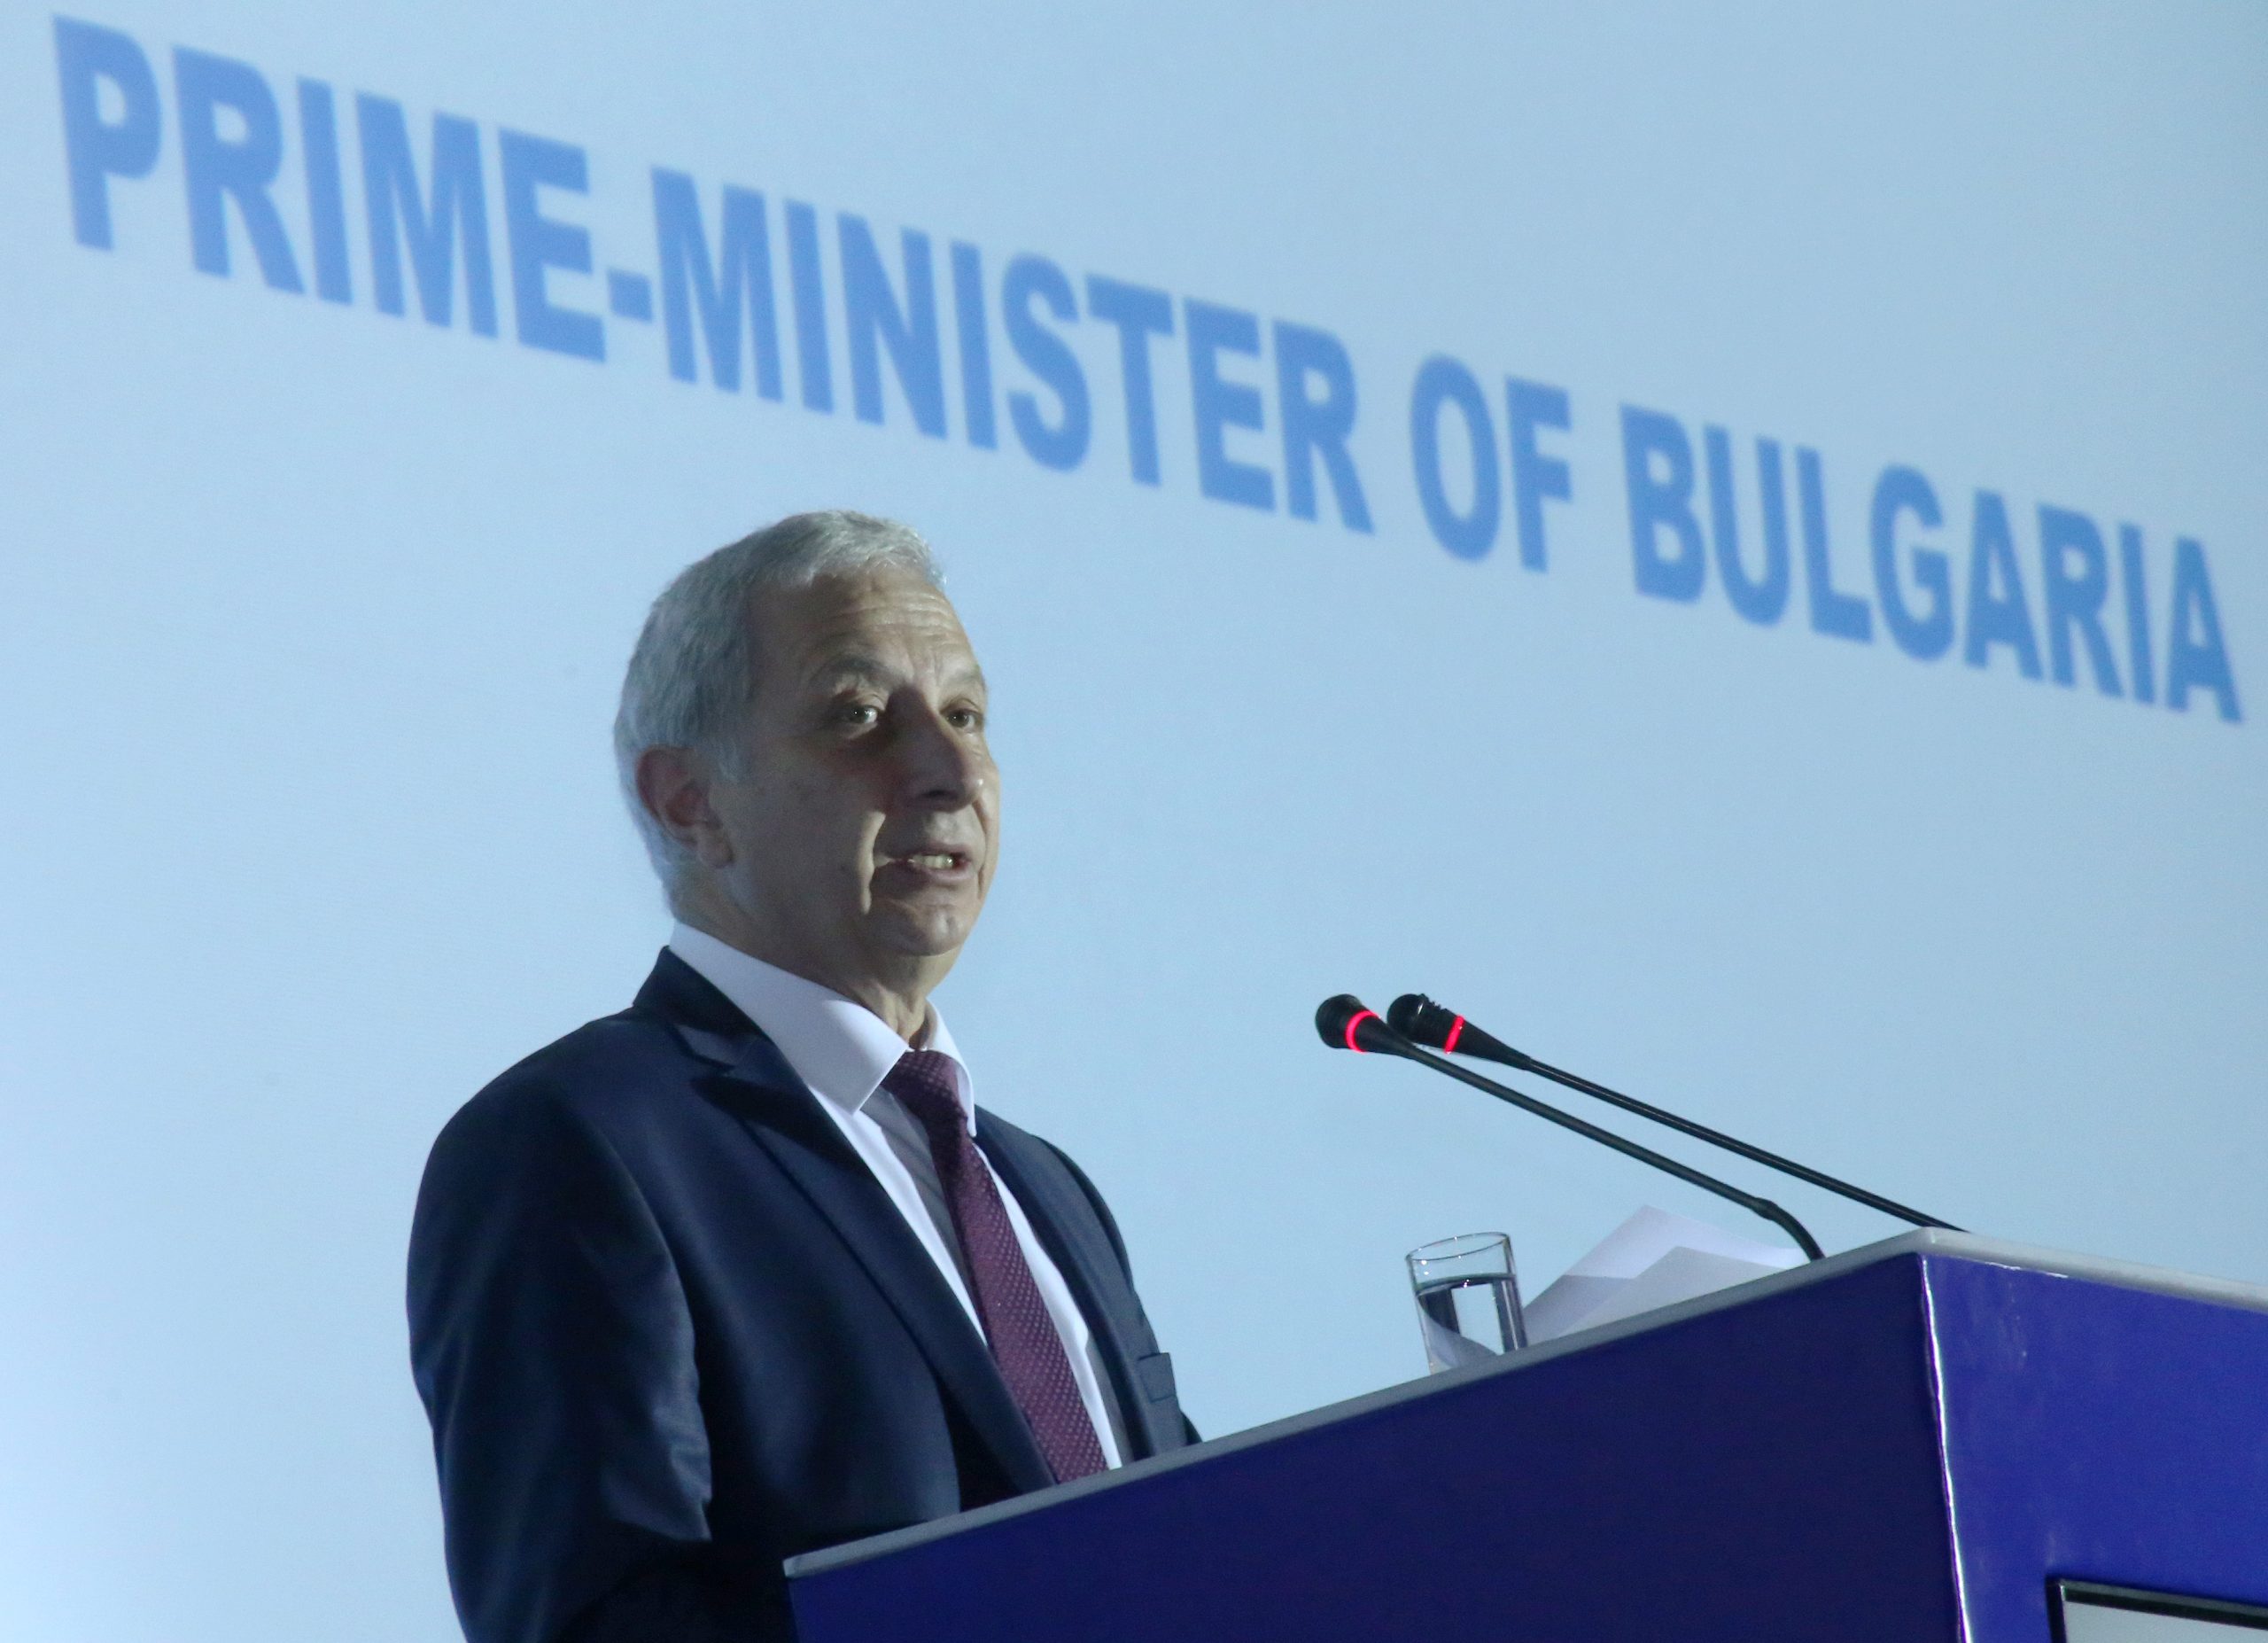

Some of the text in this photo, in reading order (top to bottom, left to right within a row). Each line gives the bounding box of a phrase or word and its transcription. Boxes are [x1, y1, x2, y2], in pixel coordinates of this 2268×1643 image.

[53, 15, 2245, 725] PRIME-MINISTER OF BULGARIA
